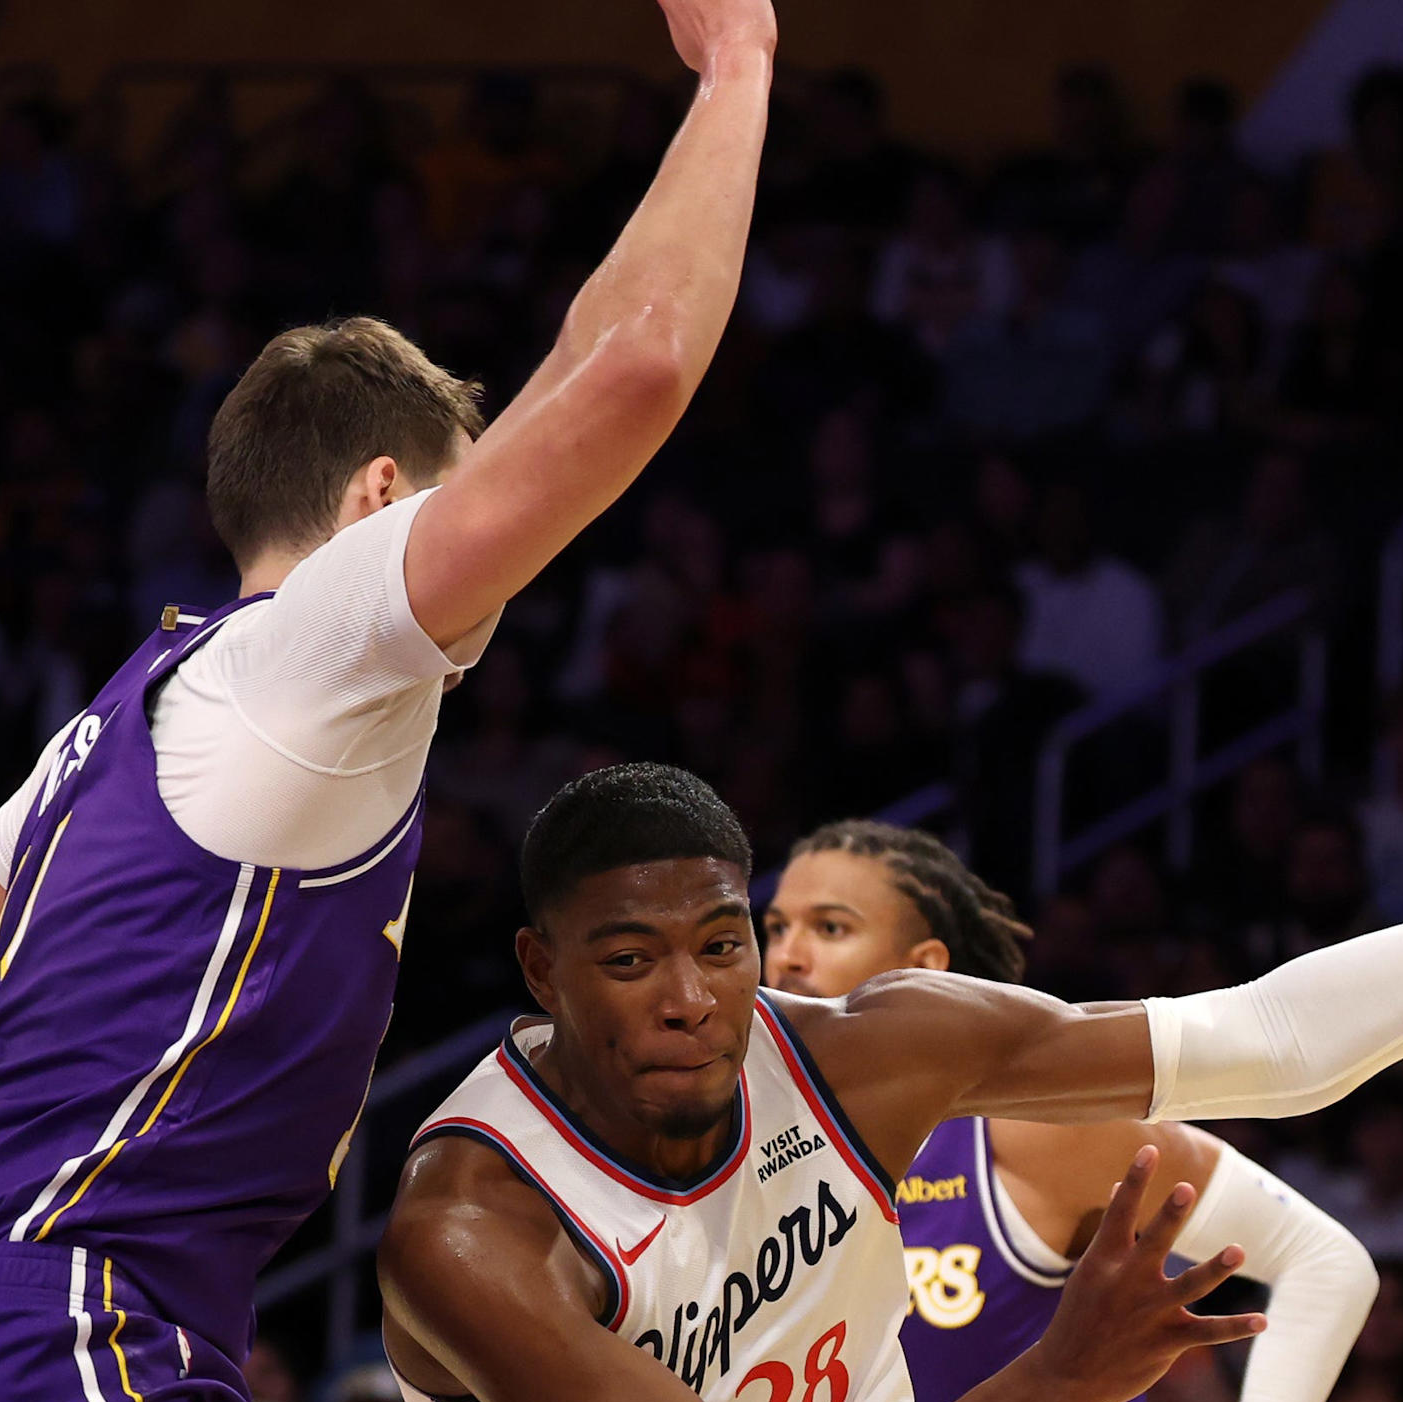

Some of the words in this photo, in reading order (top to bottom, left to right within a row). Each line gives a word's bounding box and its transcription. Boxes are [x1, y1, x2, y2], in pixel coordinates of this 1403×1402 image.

[756, 1133, 827, 1184] RWANDA
[759, 1124, 802, 1159] VISIT
[894, 1174, 969, 1204] Albert
